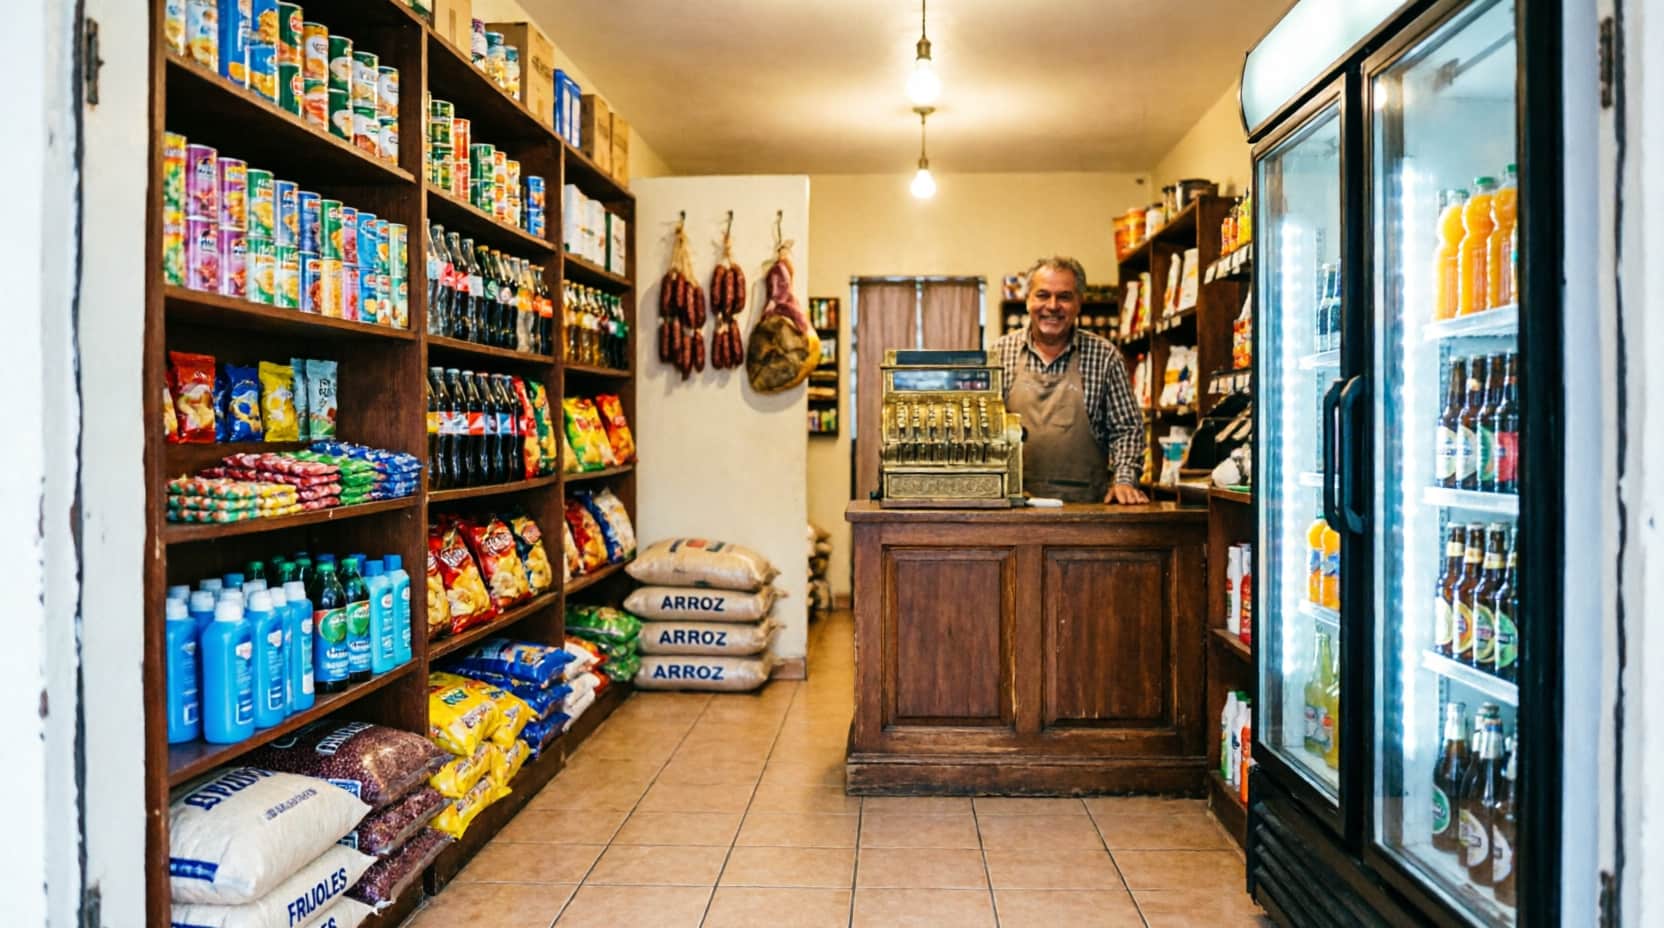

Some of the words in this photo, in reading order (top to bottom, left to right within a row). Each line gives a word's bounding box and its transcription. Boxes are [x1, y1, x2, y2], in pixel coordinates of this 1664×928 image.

[661, 595, 725, 612] ARROZ
[659, 629, 727, 646] ARROZ
[653, 664, 724, 680] ARROZ
[287, 867, 347, 928] FRIJOLES
